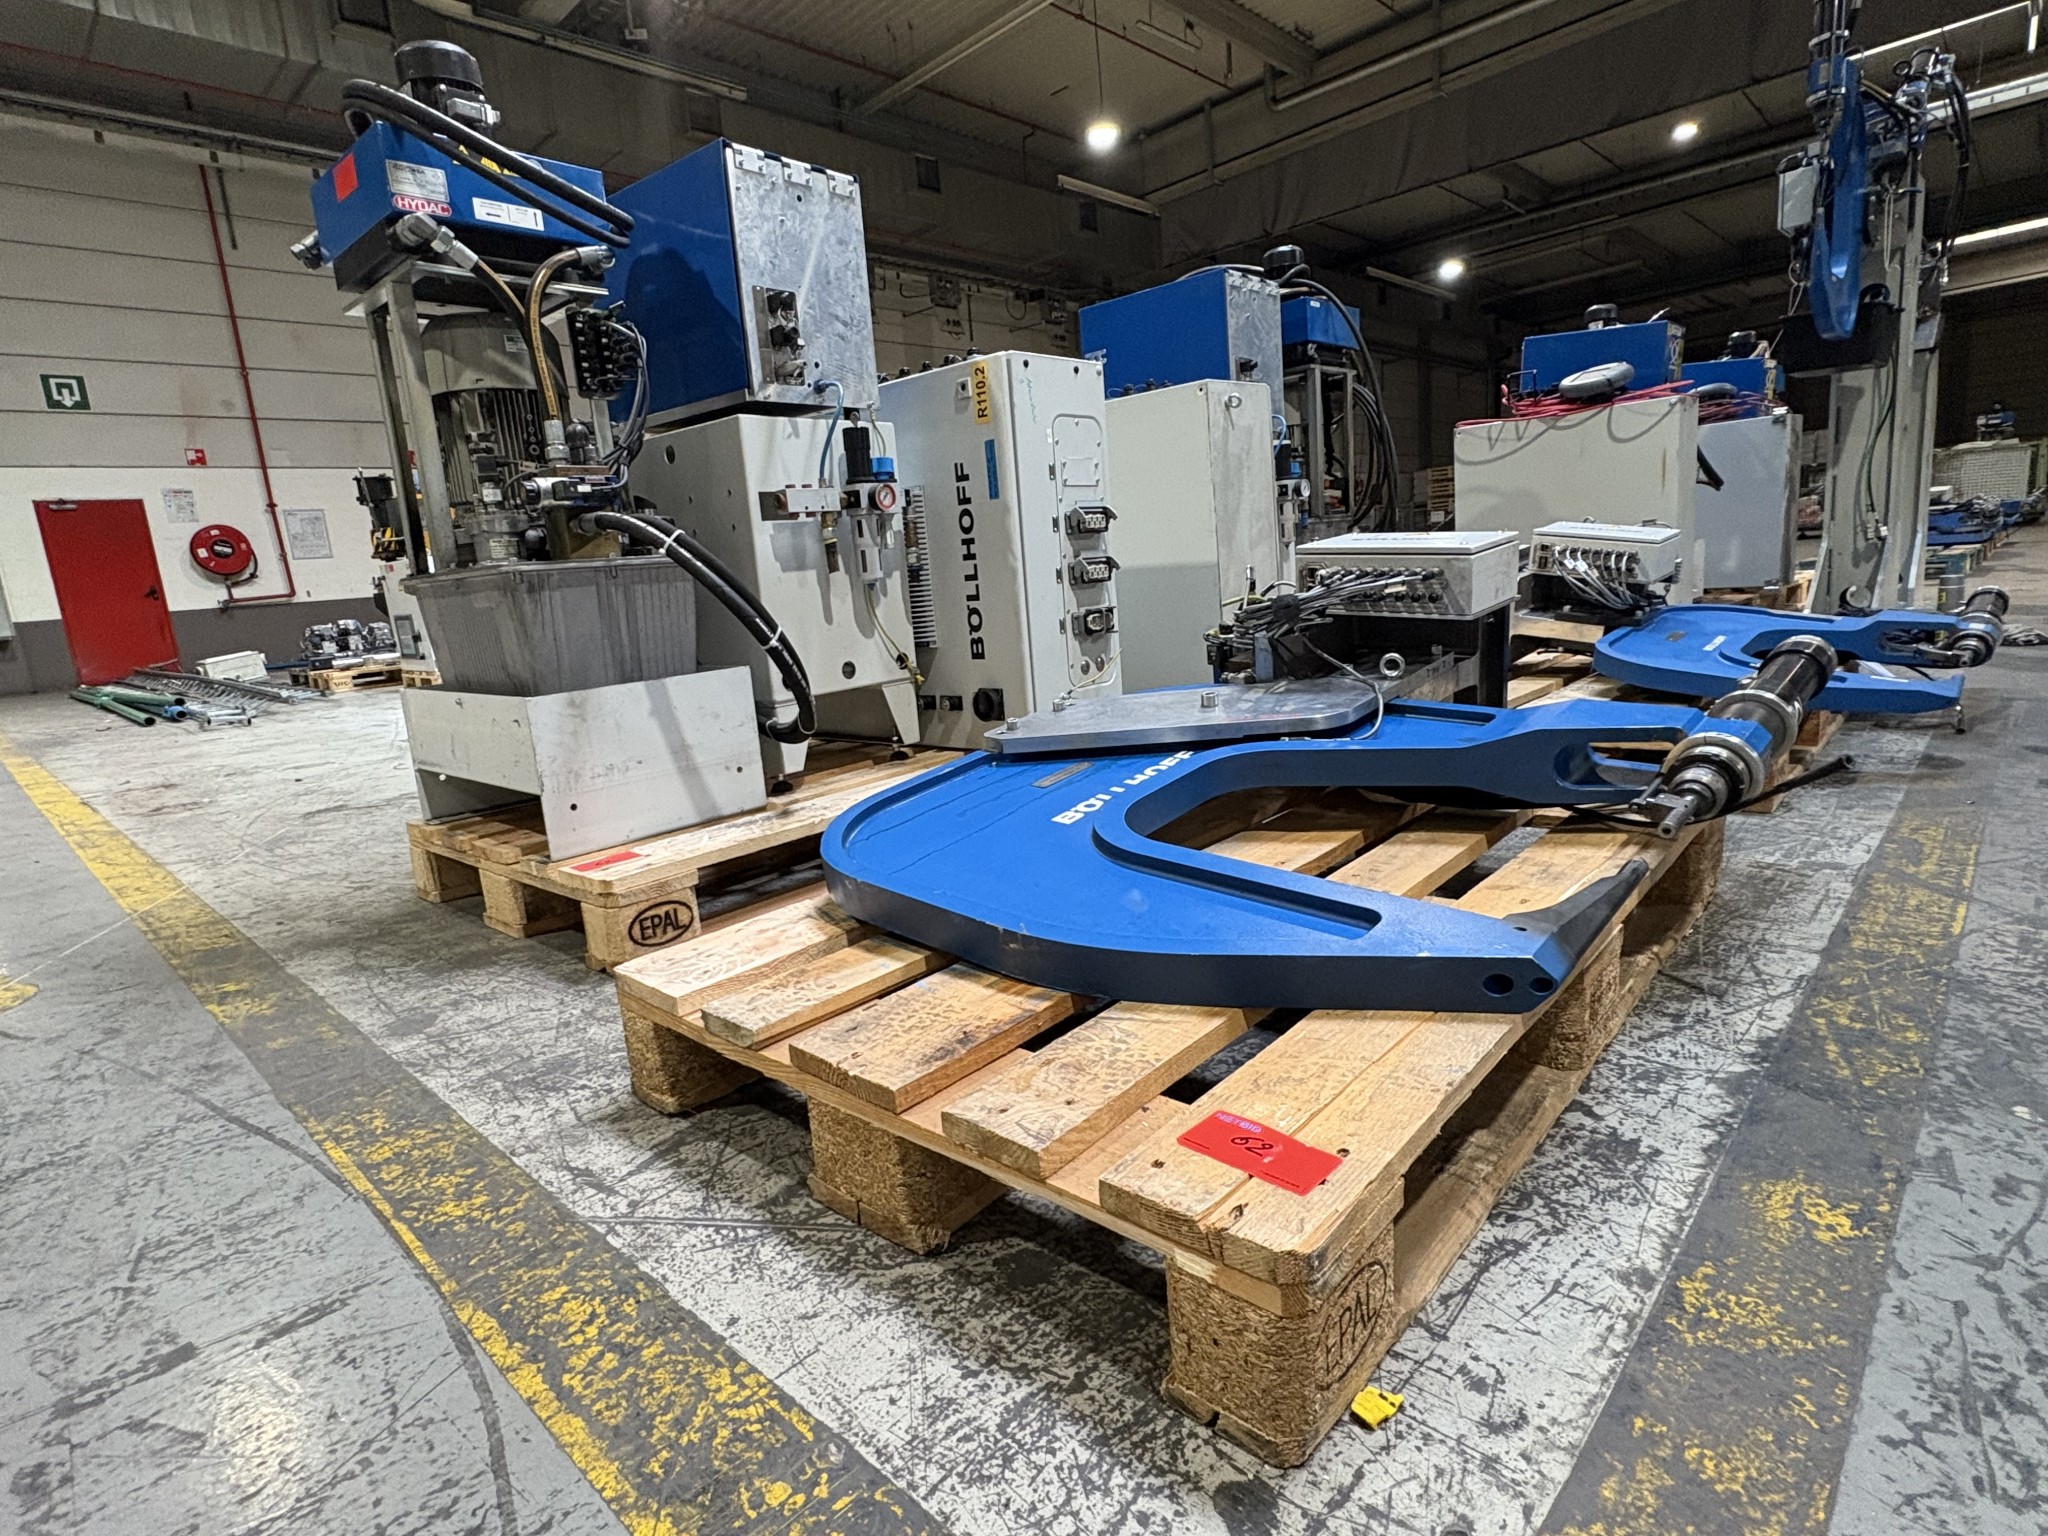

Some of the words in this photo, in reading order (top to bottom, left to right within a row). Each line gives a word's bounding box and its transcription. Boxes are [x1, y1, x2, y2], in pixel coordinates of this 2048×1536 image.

[398, 195, 449, 216] HYDAC
[974, 365, 988, 419] R110.2
[638, 907, 687, 941] EPAL
[1231, 1136, 1274, 1157] 62
[1325, 1278, 1377, 1376] EPAL
